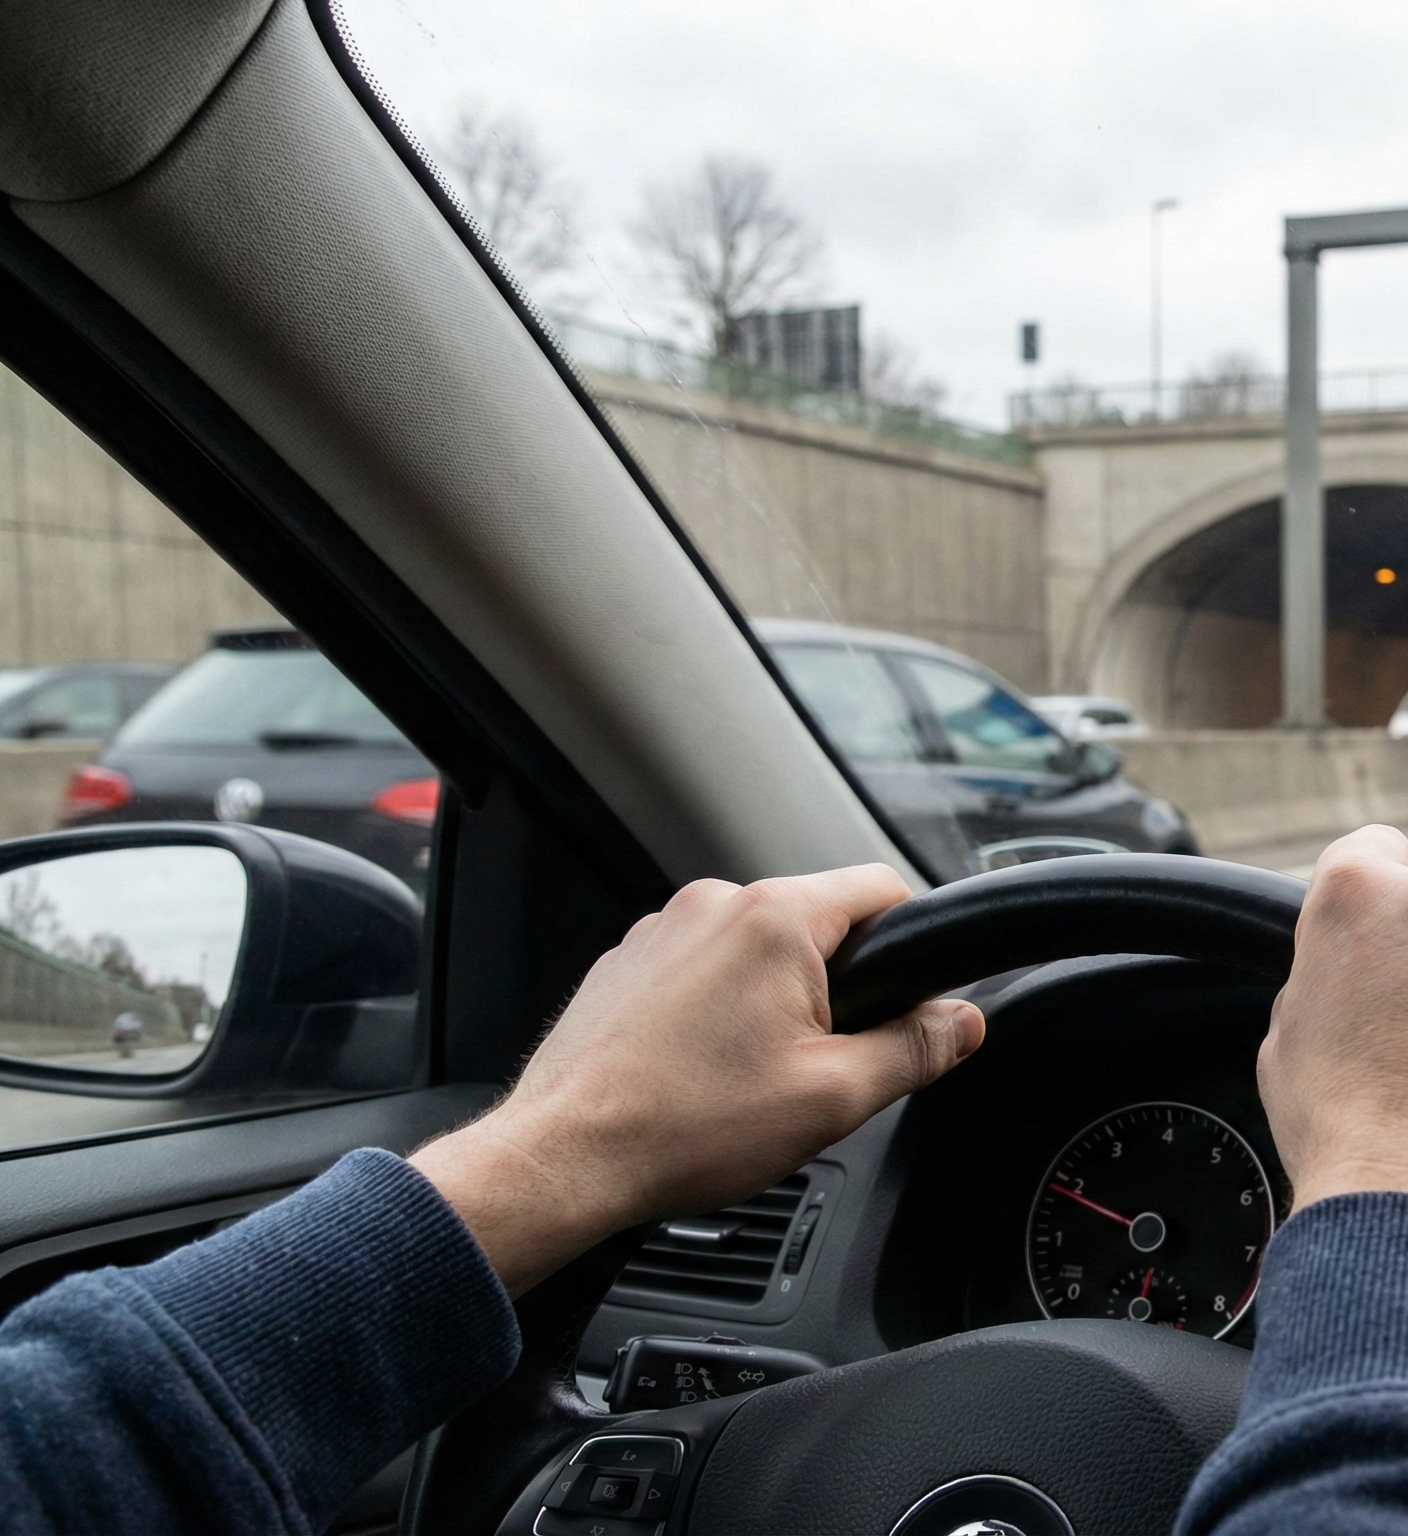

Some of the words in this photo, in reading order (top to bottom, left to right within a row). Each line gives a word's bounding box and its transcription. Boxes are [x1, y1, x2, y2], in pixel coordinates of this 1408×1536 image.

[1161, 1127, 1174, 1145] 4
[1111, 1141, 1123, 1158] 3
[1210, 1147, 1222, 1164] 5
[1072, 1178, 1084, 1195] 2
[1240, 1189, 1253, 1206] 6
[1054, 1230, 1063, 1247] 1
[1245, 1245, 1257, 1262] 7
[1067, 1282, 1080, 1300] 0
[1213, 1294, 1226, 1313] 8
